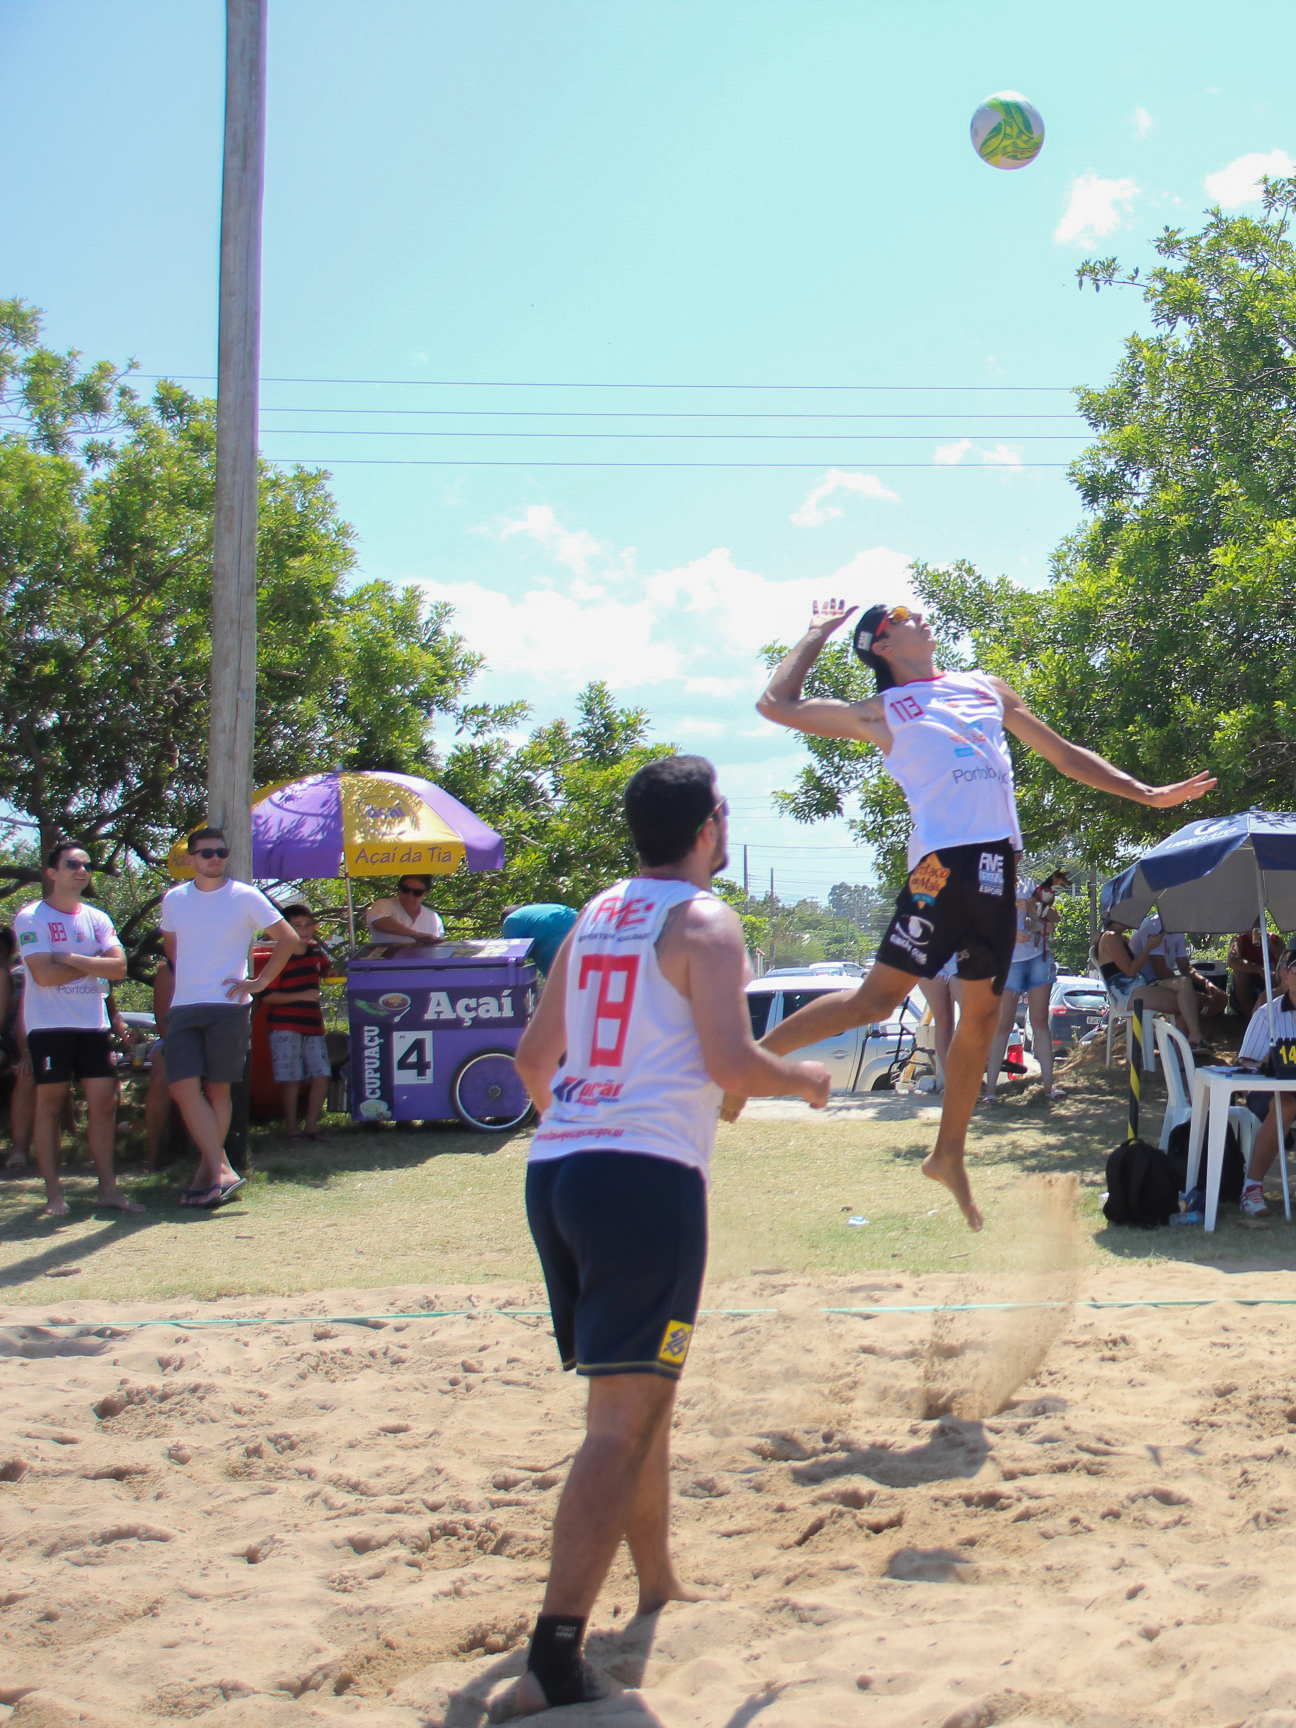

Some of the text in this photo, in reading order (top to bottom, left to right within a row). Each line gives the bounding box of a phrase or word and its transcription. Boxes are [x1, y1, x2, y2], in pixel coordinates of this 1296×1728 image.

[890, 695, 924, 722] 113
[355, 846, 452, 866] Açaí da Tia
[48, 921, 68, 942] 183
[424, 988, 514, 1027] Açaí
[364, 1025, 384, 1100] CUPUAÇU
[397, 1037, 432, 1078] 4
